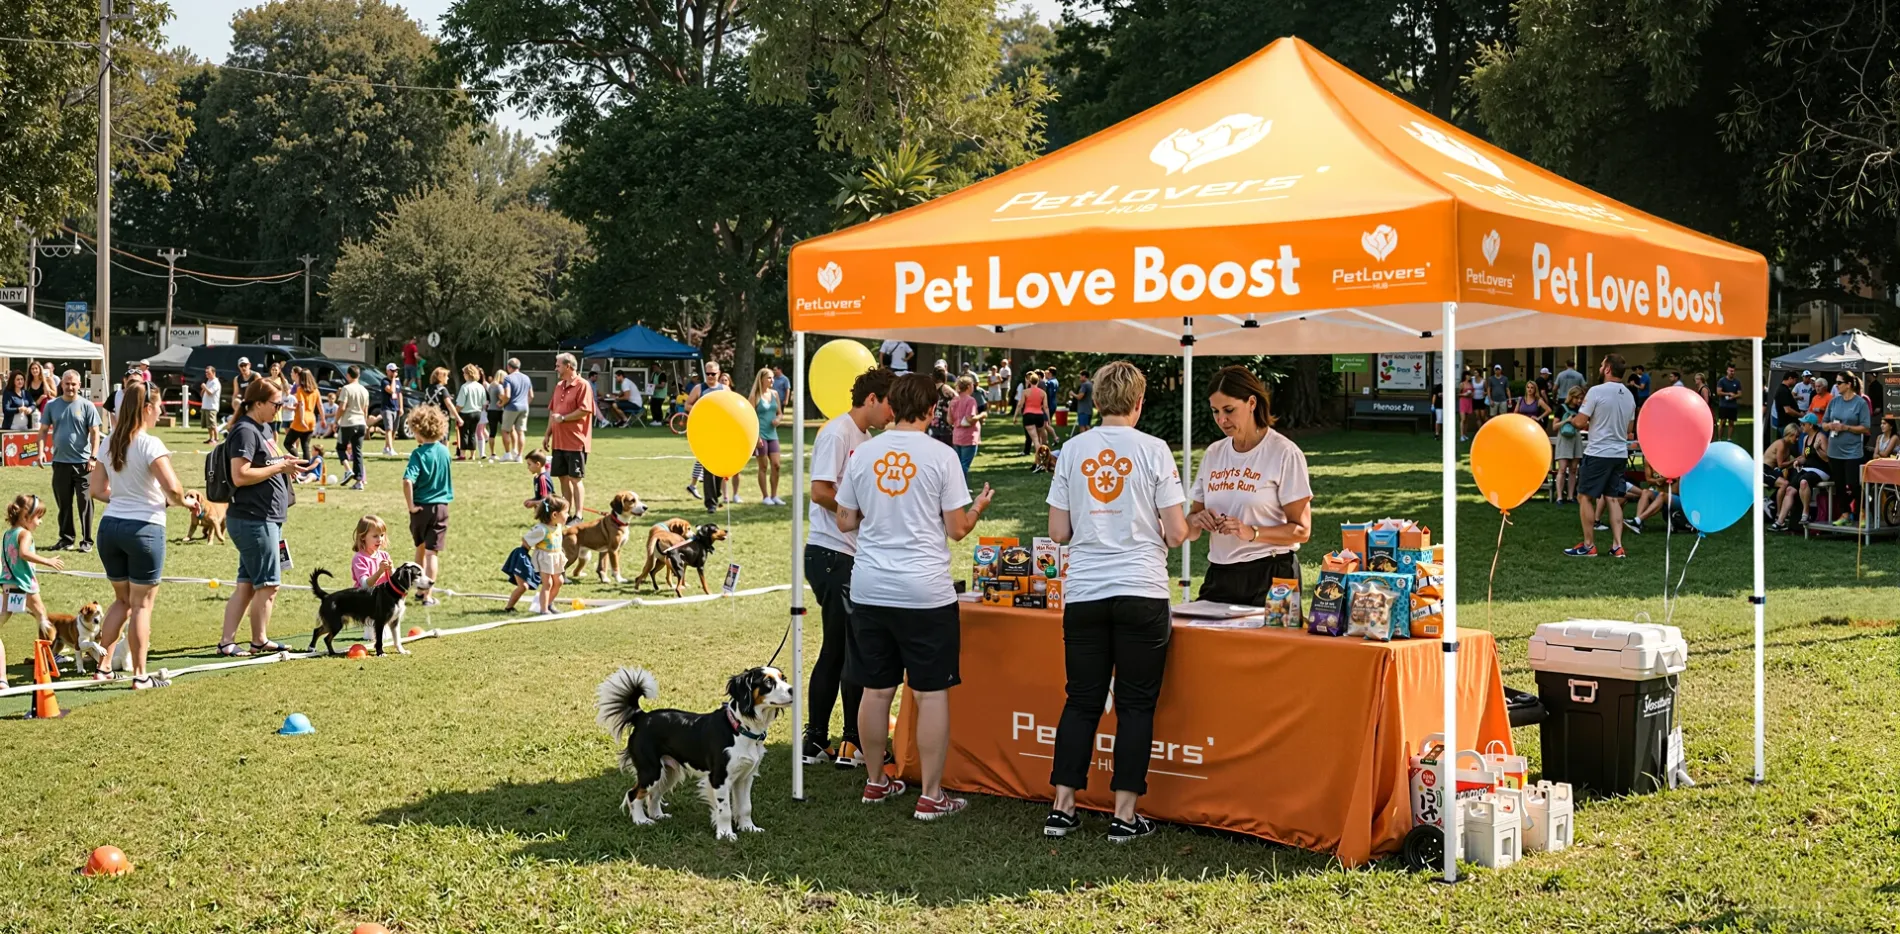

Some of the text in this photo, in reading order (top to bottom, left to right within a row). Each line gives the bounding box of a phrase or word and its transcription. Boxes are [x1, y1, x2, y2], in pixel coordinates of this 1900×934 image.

[1106, 203, 1158, 215] HUB
[894, 244, 1301, 314] Pet Love Boost
[1531, 242, 1724, 325] Pet Love Boost
[1243, 467, 1261, 481] Run
[1237, 480, 1257, 493] Run.
